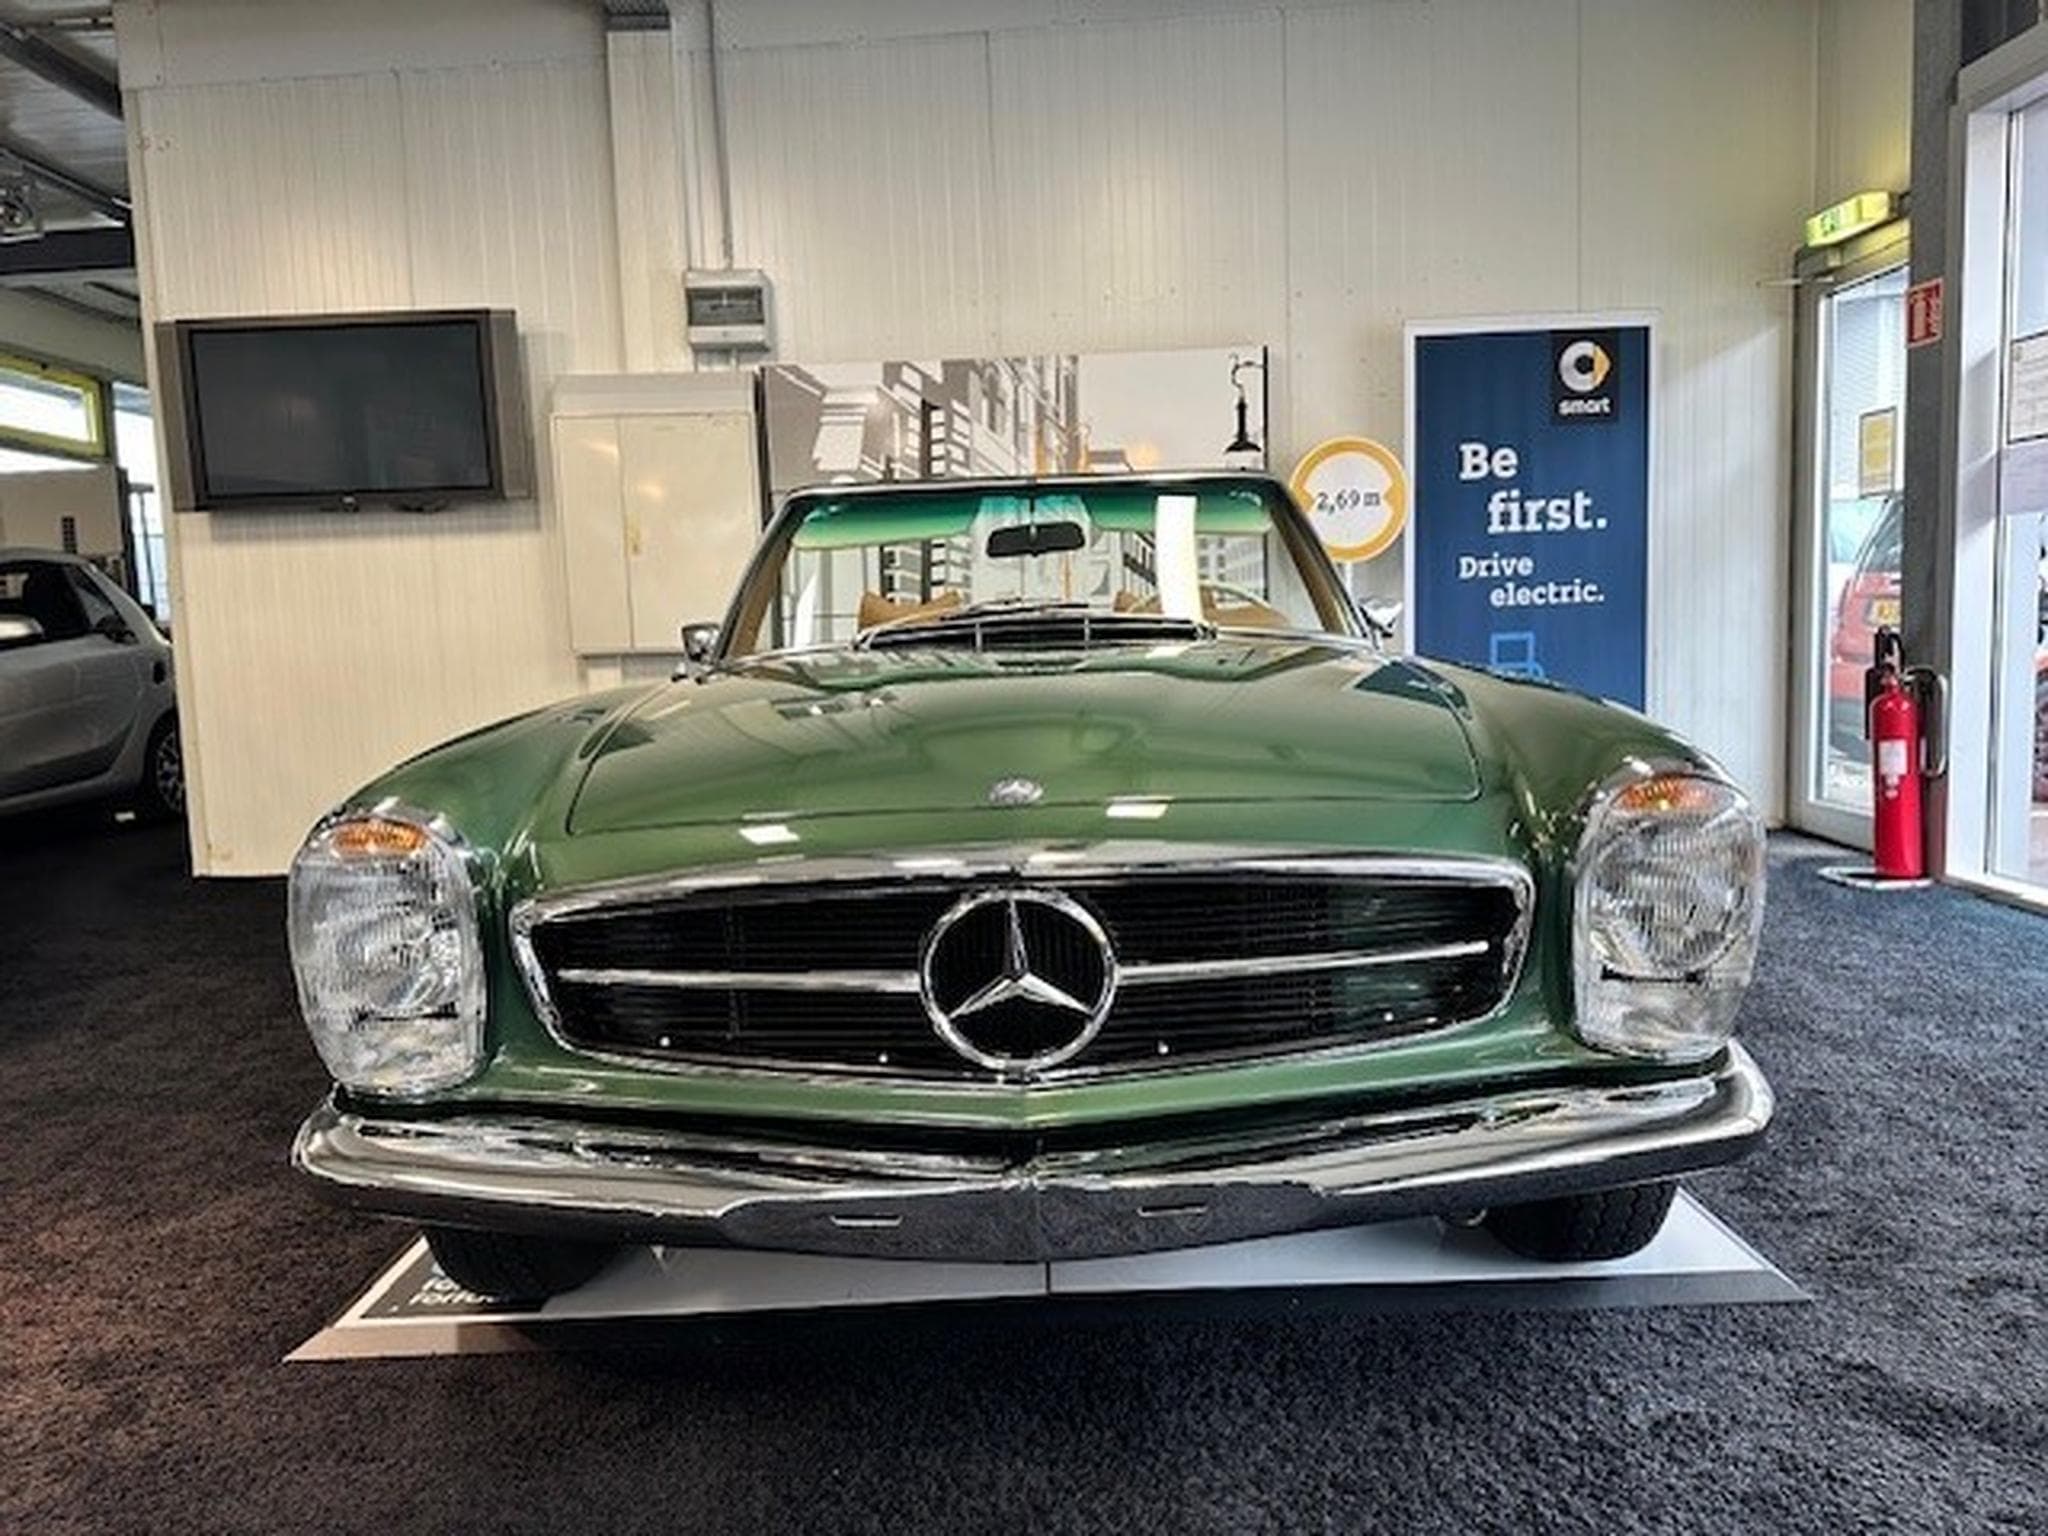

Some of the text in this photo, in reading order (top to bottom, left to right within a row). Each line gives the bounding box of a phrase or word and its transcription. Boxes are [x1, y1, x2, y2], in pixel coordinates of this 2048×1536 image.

[1558, 397, 1611, 415] smart
[1459, 443, 1518, 480] Be
[1316, 490, 1381, 516] 2,69 m
[1487, 489, 1608, 535] first.
[1459, 552, 1534, 580] Drive
[1490, 578, 1605, 608] electric.
